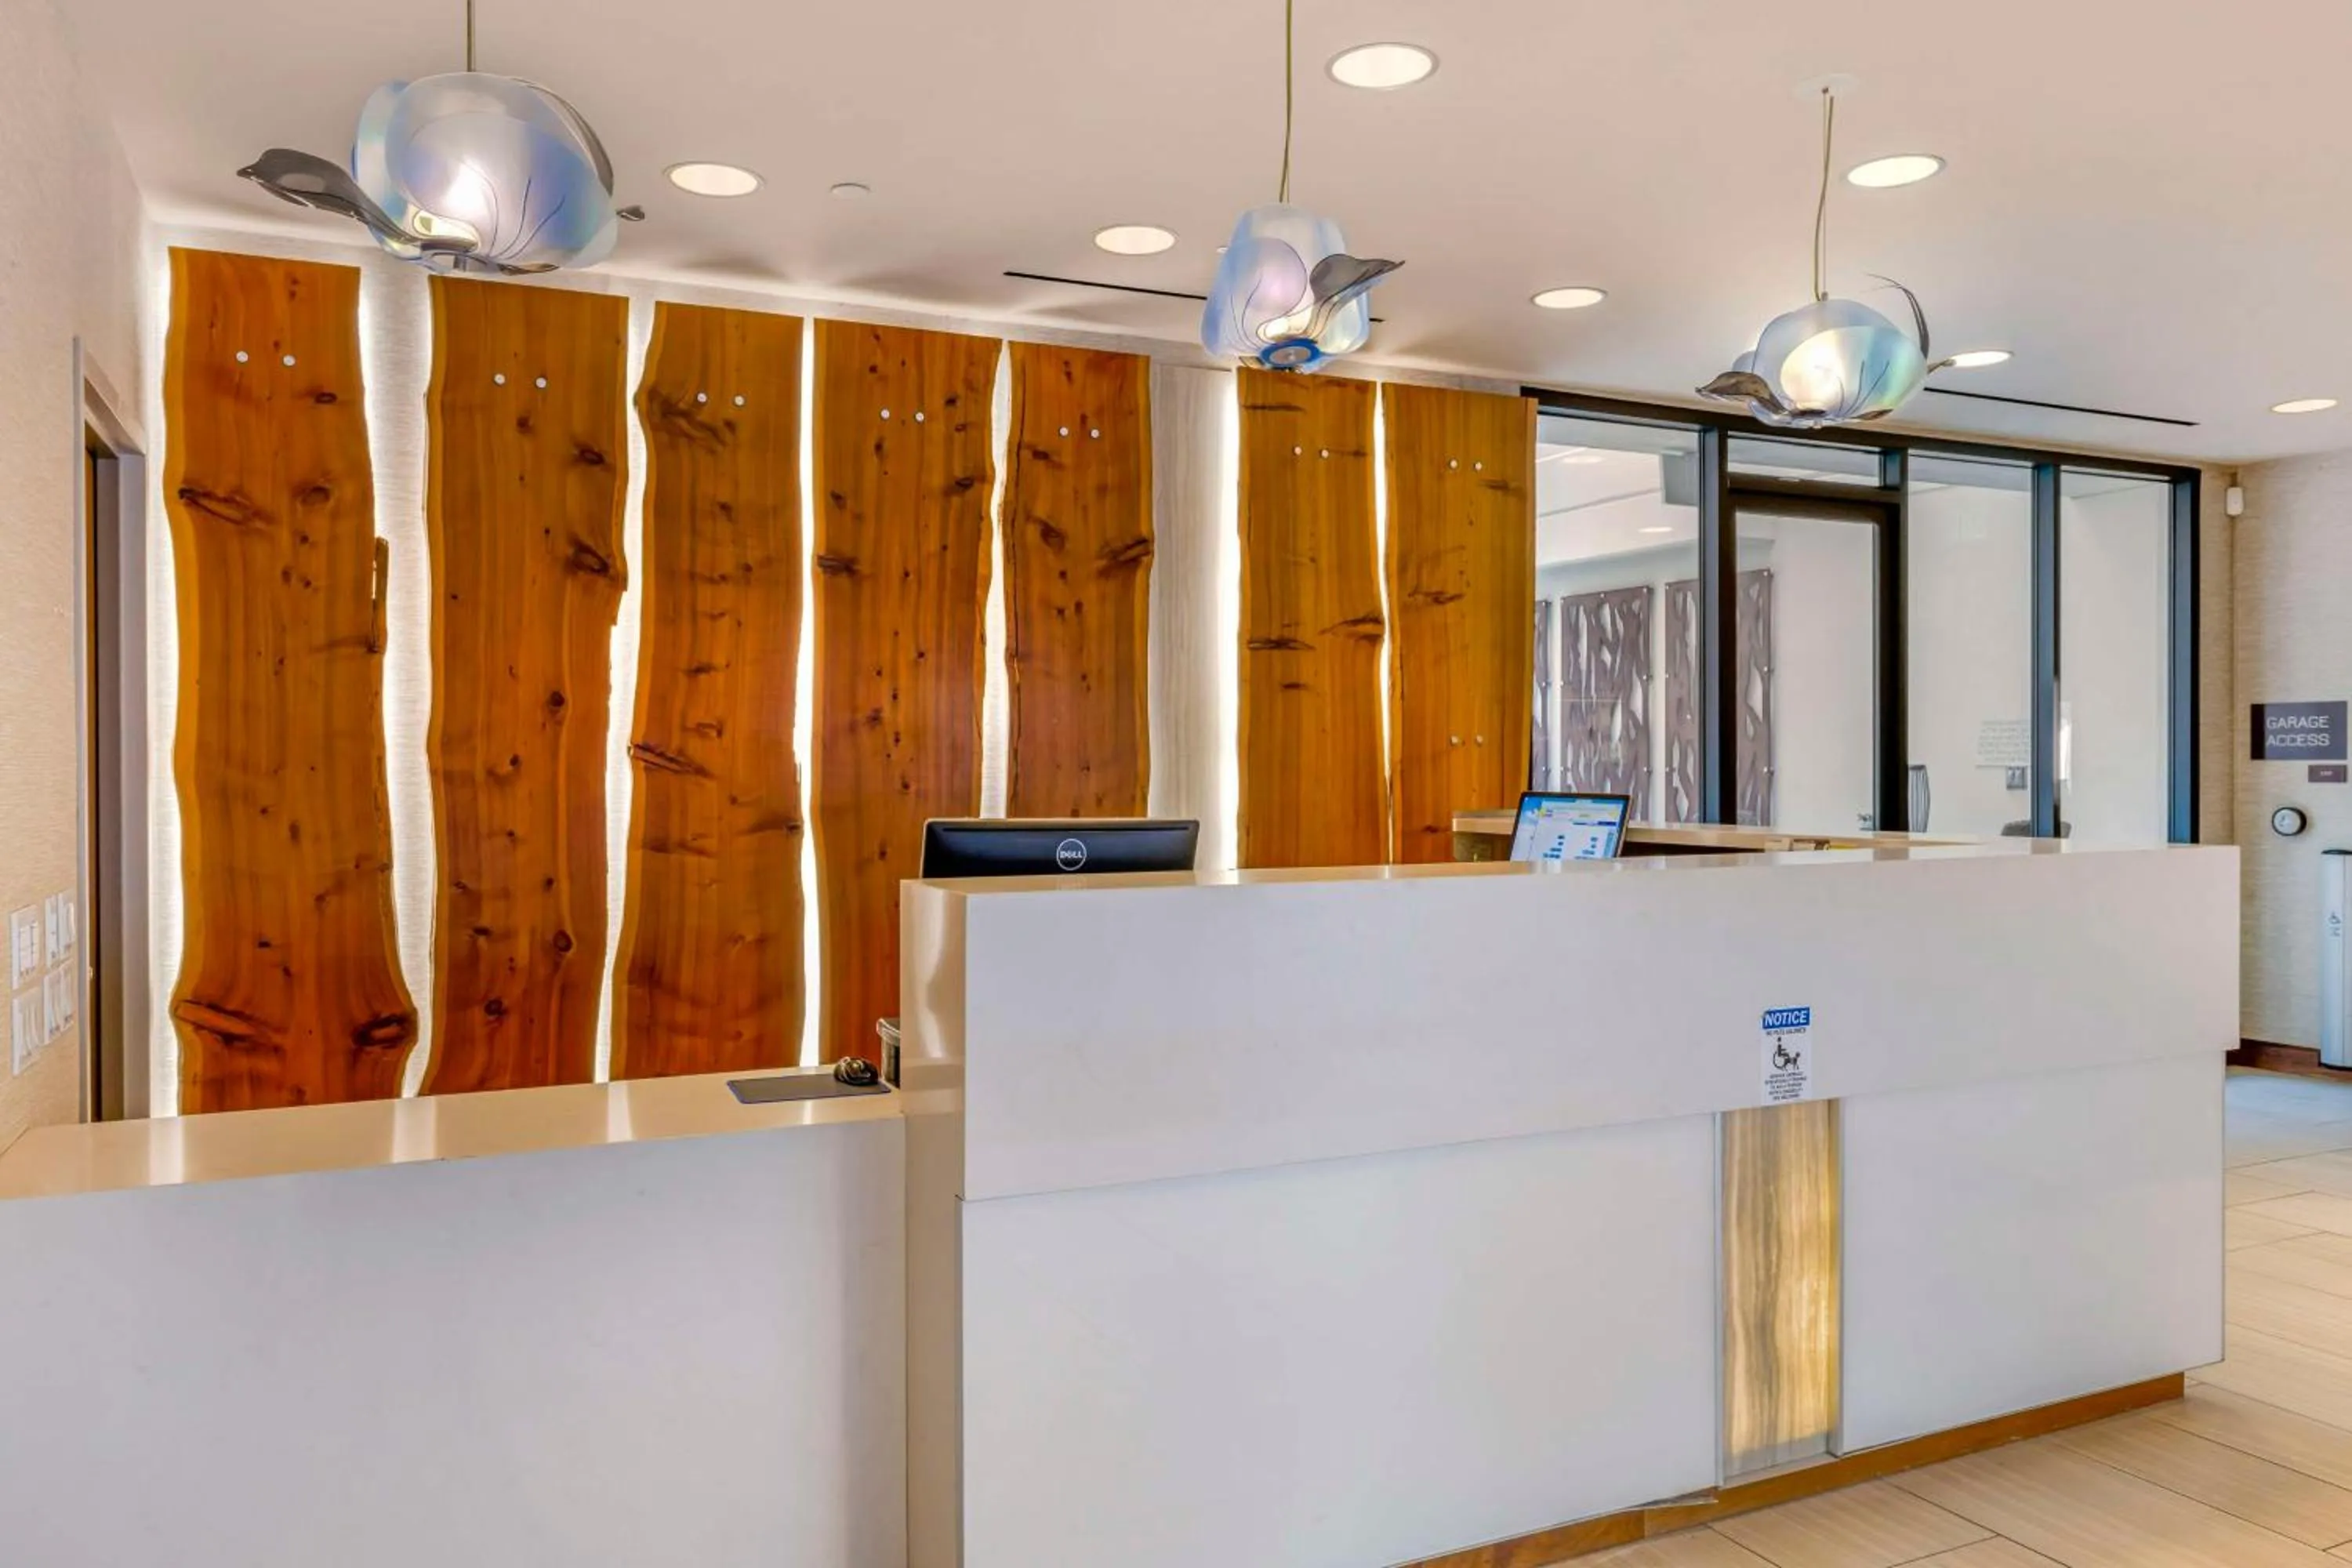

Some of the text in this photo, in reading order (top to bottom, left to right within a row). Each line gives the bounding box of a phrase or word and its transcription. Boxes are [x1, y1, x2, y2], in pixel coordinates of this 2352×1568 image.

[2267, 716, 2330, 729] GARAGE
[2267, 733, 2331, 747] ACCESS
[1765, 1010, 1807, 1027] NOTICE
